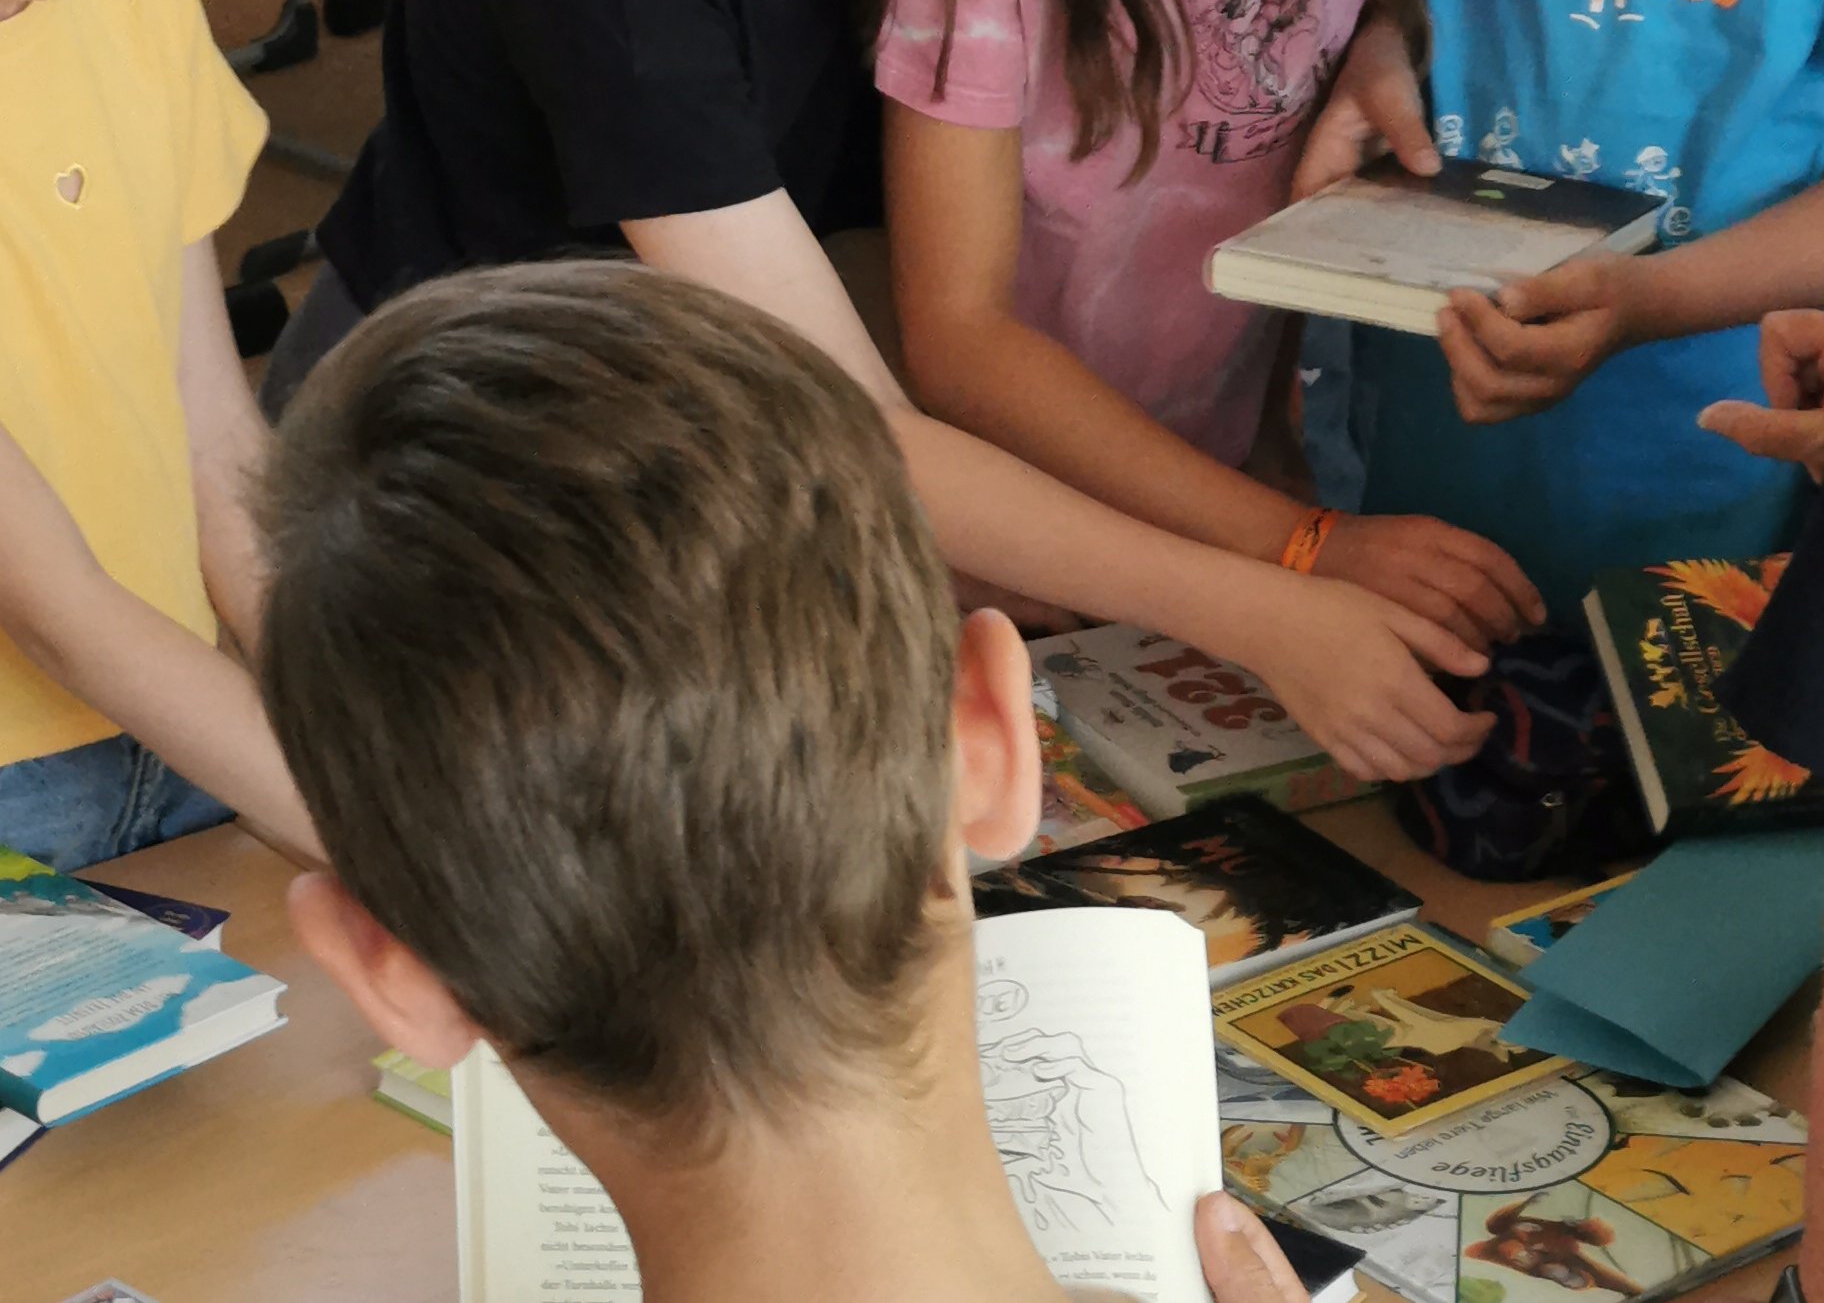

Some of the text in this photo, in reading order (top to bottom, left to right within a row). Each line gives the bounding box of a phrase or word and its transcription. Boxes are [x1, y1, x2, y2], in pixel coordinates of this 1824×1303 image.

[1297, 961, 1339, 983] DAS
[1340, 932, 1423, 972] MIZZI
[1431, 1121, 1595, 1183] Eintagsfliege
